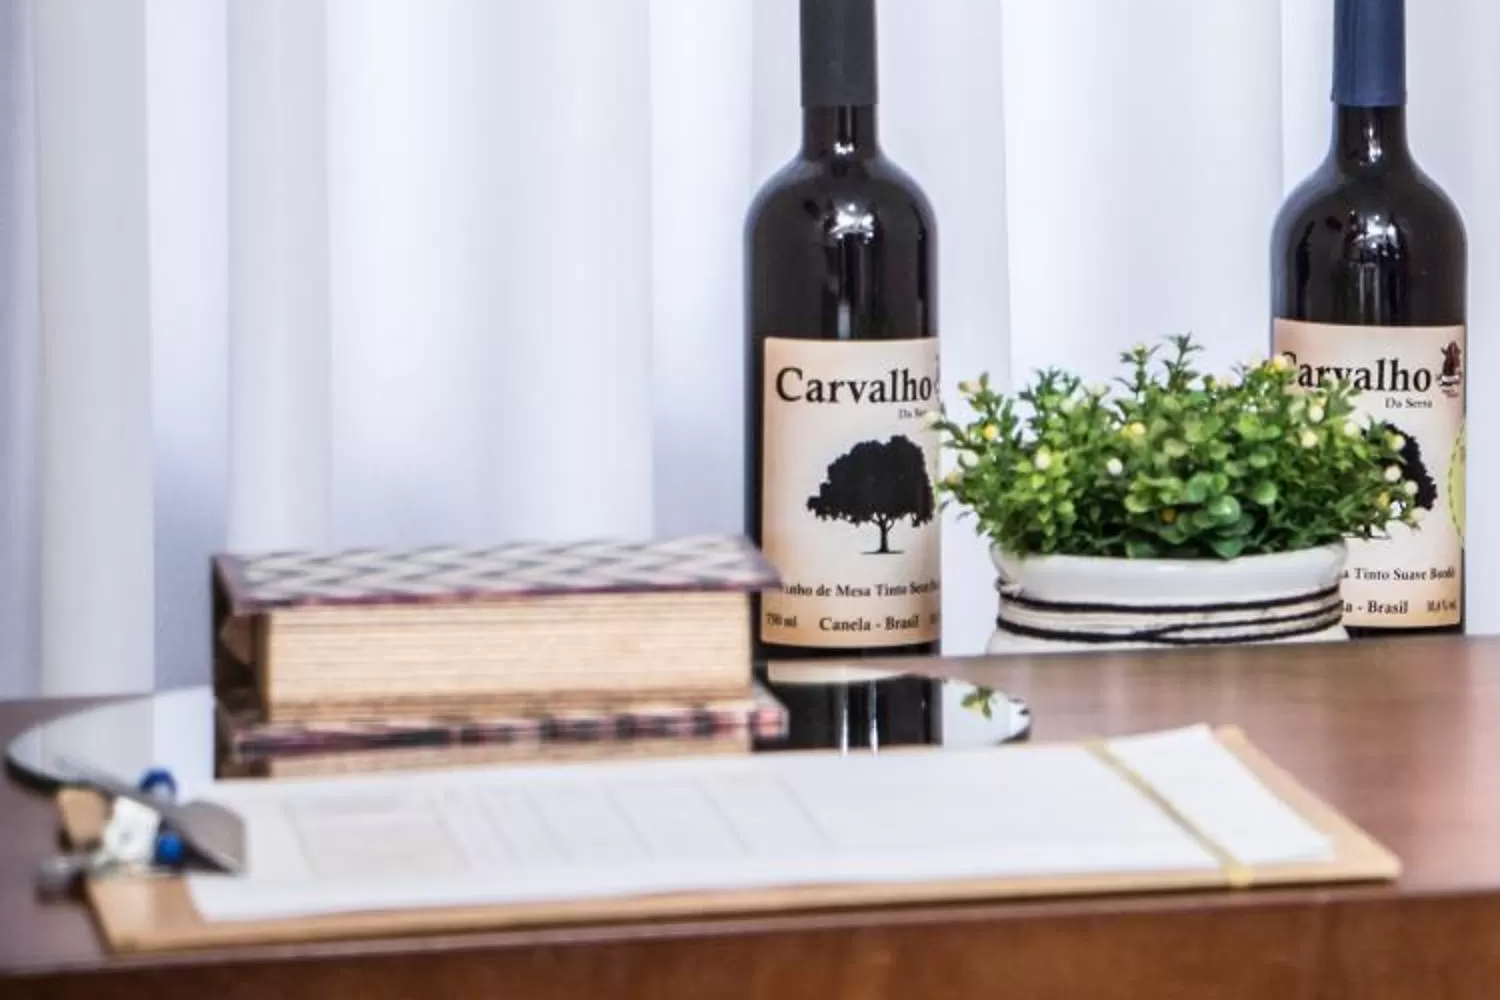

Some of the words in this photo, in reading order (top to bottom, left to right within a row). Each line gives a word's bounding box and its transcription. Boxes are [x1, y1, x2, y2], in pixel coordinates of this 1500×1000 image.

[775, 367, 932, 404] Carvalho
[1354, 567, 1390, 580] Tinto
[1393, 567, 1426, 580] Suave
[780, 583, 813, 597] inho
[816, 583, 832, 597] de
[835, 583, 871, 597] Mesa
[1367, 599, 1408, 614] Brasil
[819, 616, 871, 632] Canela
[885, 613, 919, 631] Brasil
